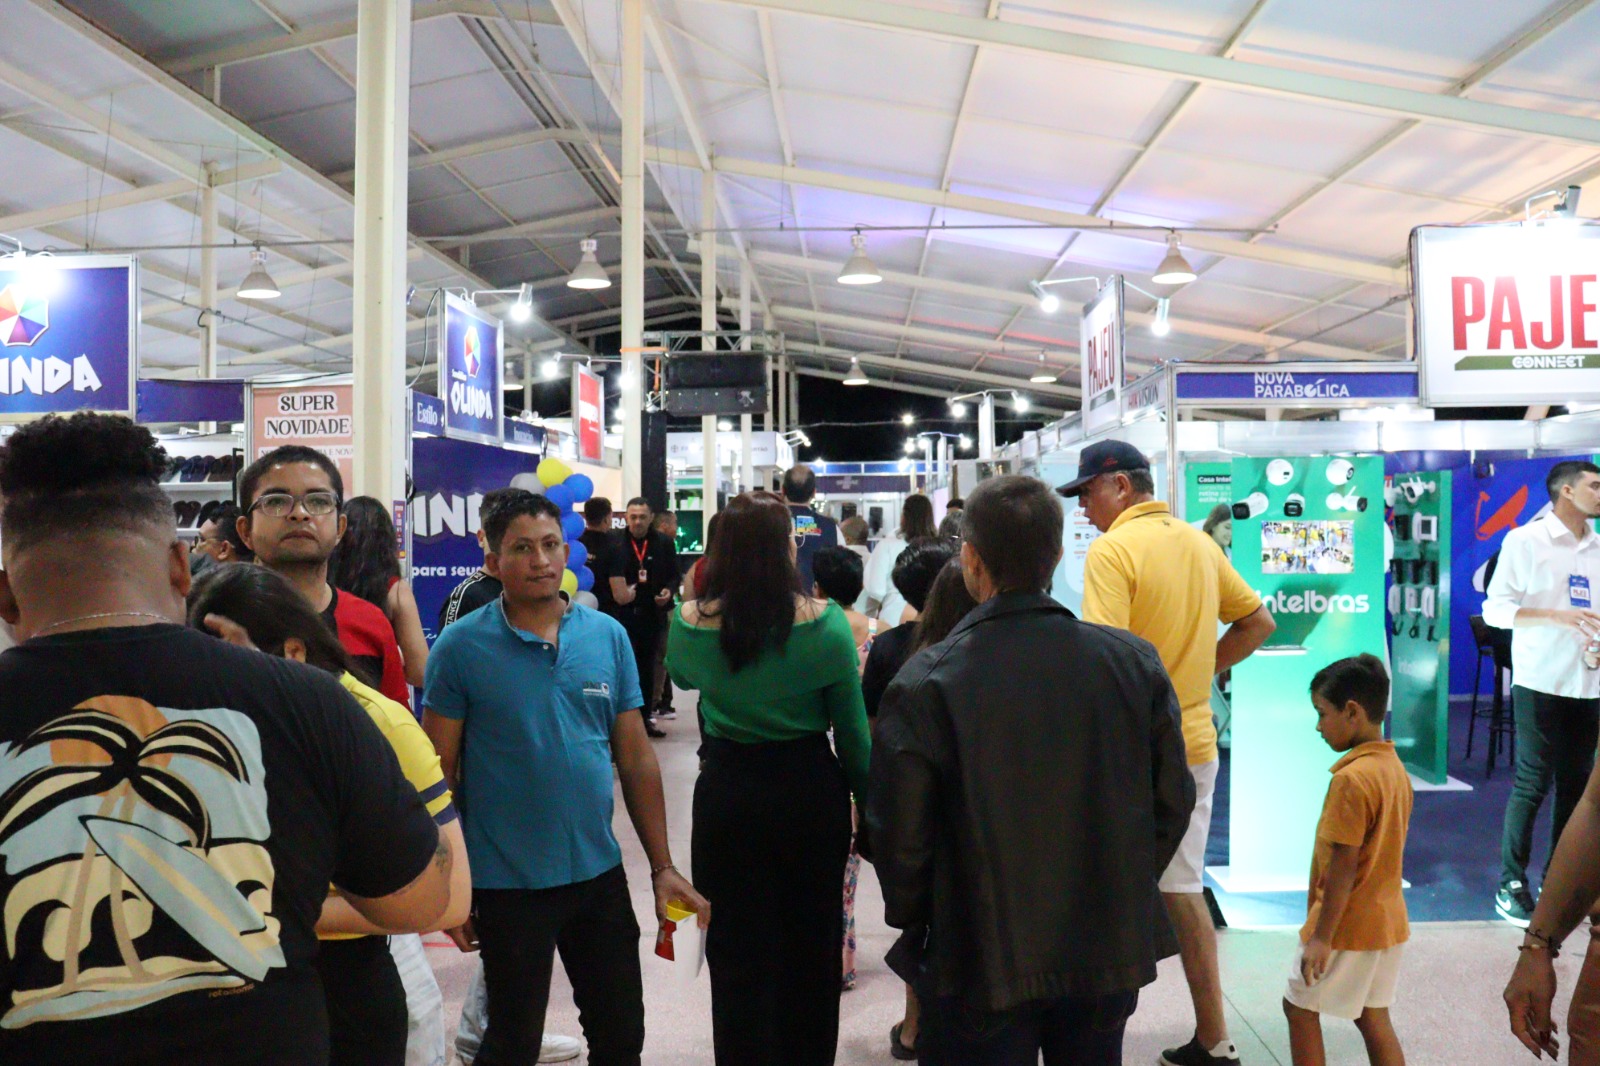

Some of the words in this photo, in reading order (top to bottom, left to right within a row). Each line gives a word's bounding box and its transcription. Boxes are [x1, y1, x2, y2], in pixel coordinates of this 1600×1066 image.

[1451, 274, 1598, 350] PAJE
[1512, 355, 1586, 368] CONNECT
[1254, 372, 1295, 384] NOVA
[1254, 379, 1350, 398] PARABÓLICA
[280, 395, 335, 411] SUPER
[450, 381, 494, 420] OLINDA
[417, 402, 438, 426] Estilo
[266, 418, 350, 435] NOVIDADE
[412, 566, 447, 579] para
